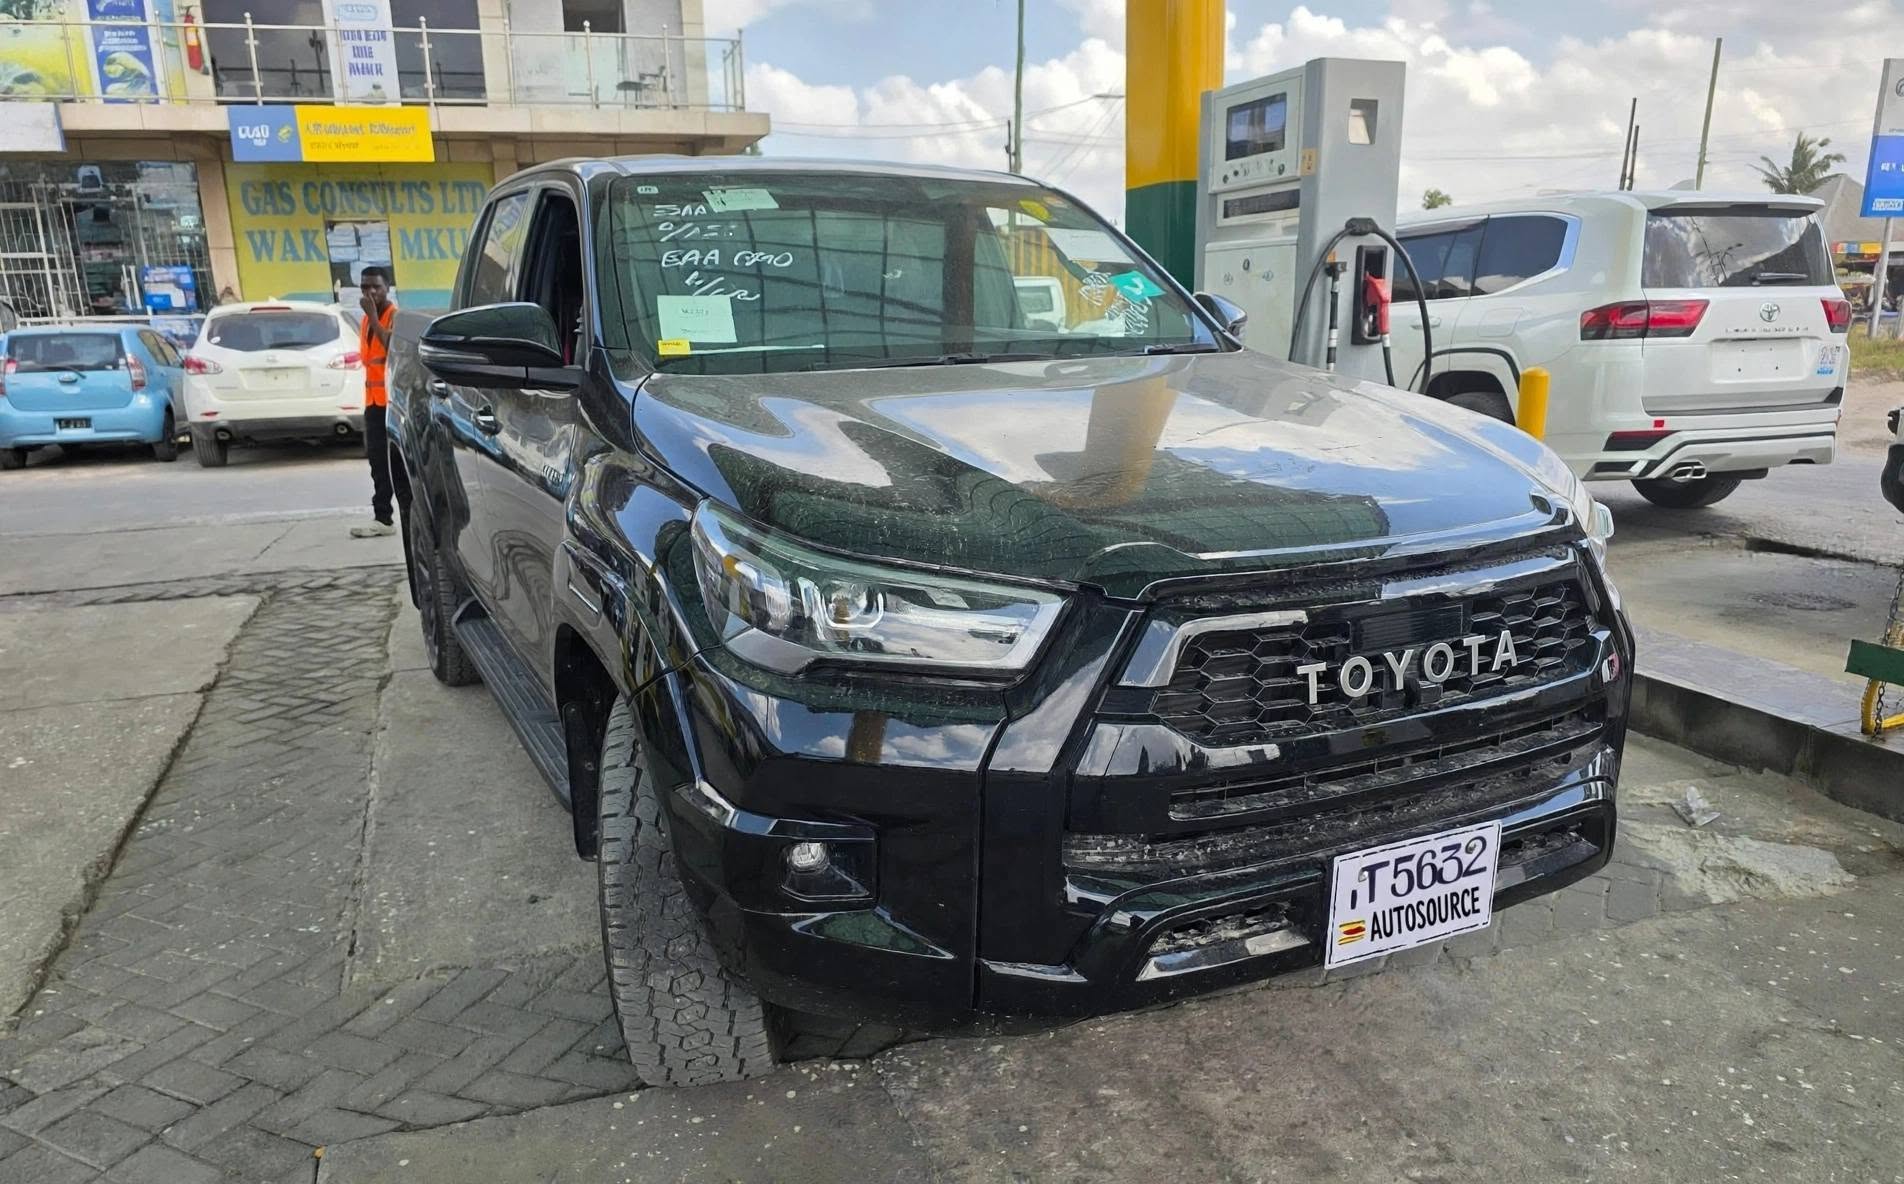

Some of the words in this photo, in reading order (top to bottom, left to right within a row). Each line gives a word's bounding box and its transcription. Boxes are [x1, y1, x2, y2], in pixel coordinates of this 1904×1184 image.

[241, 180, 296, 216] GAS
[303, 180, 435, 215] CONSULTS
[439, 180, 489, 214] LTD
[1296, 630, 1518, 705] TOYOTA
[1370, 886, 1481, 942] AUTOSOURCE
